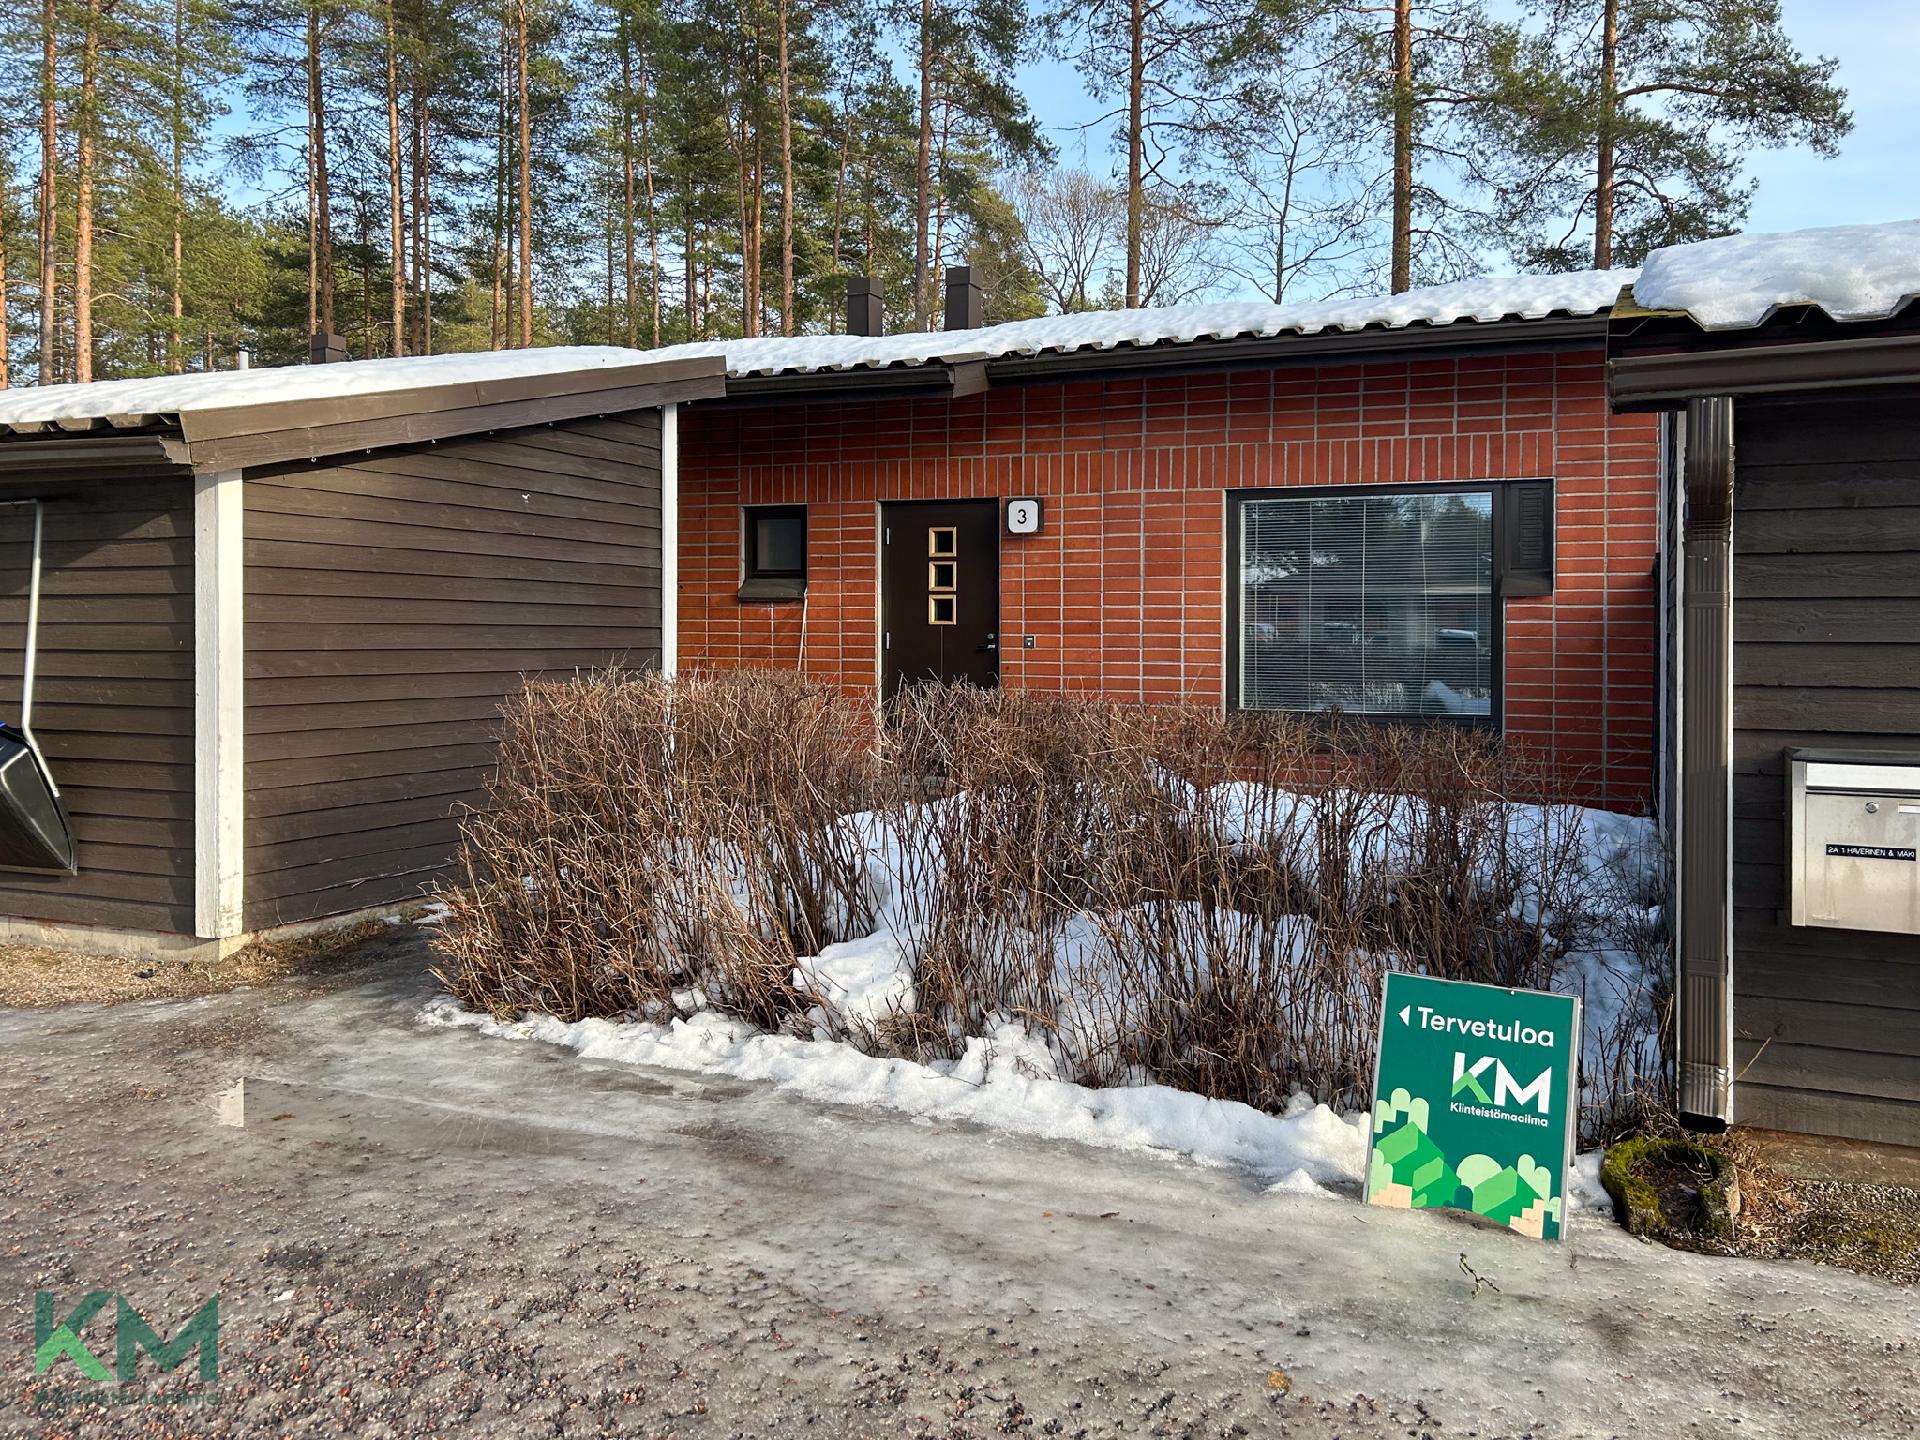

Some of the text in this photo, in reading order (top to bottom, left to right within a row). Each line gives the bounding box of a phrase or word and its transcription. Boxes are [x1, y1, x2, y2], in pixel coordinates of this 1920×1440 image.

[1017, 509, 1027, 524] 3
[1417, 1006, 1554, 1047] Tervetuloa
[1451, 1051, 1552, 1114] KM
[1450, 1102, 1549, 1127] Kiinteistömaailma
